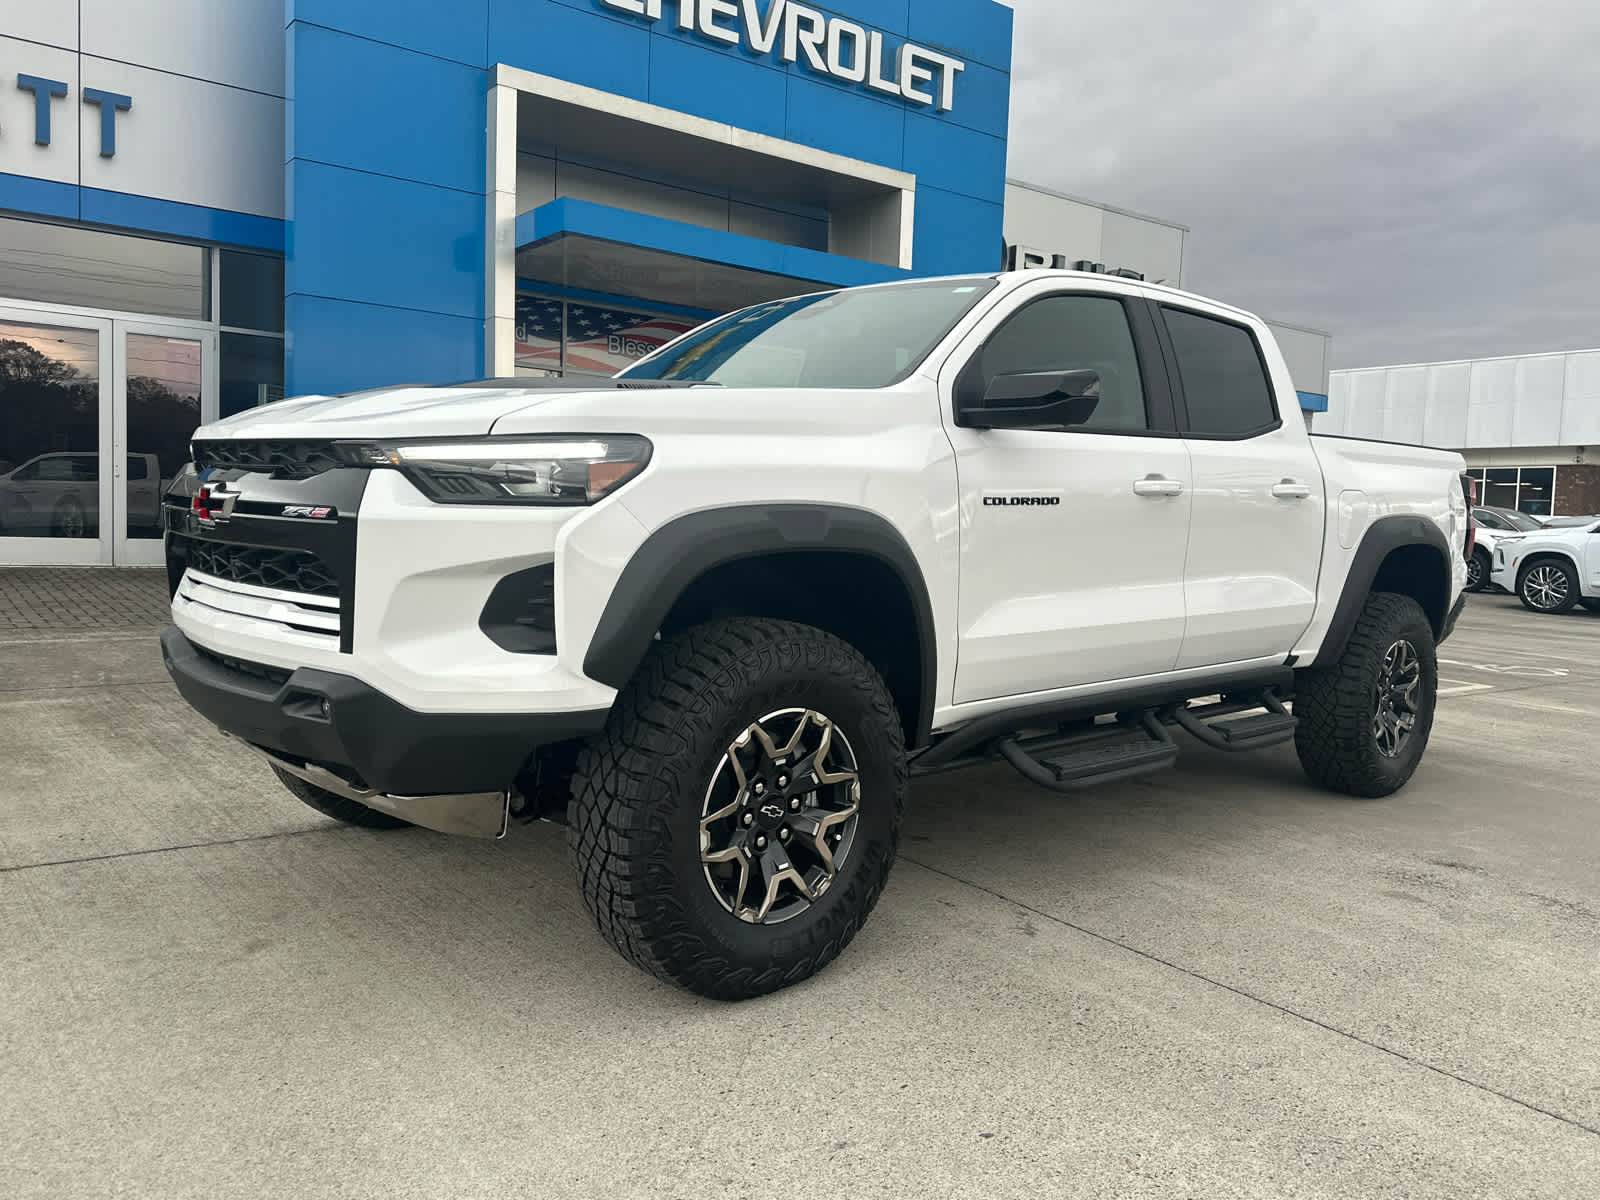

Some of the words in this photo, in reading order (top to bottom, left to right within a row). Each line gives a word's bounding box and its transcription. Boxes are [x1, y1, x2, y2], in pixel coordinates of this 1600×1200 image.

[602, 0, 965, 112] EVROLET
[0, 73, 132, 158] TT
[281, 505, 331, 519] ZR2
[983, 496, 1060, 506] COLORADO
